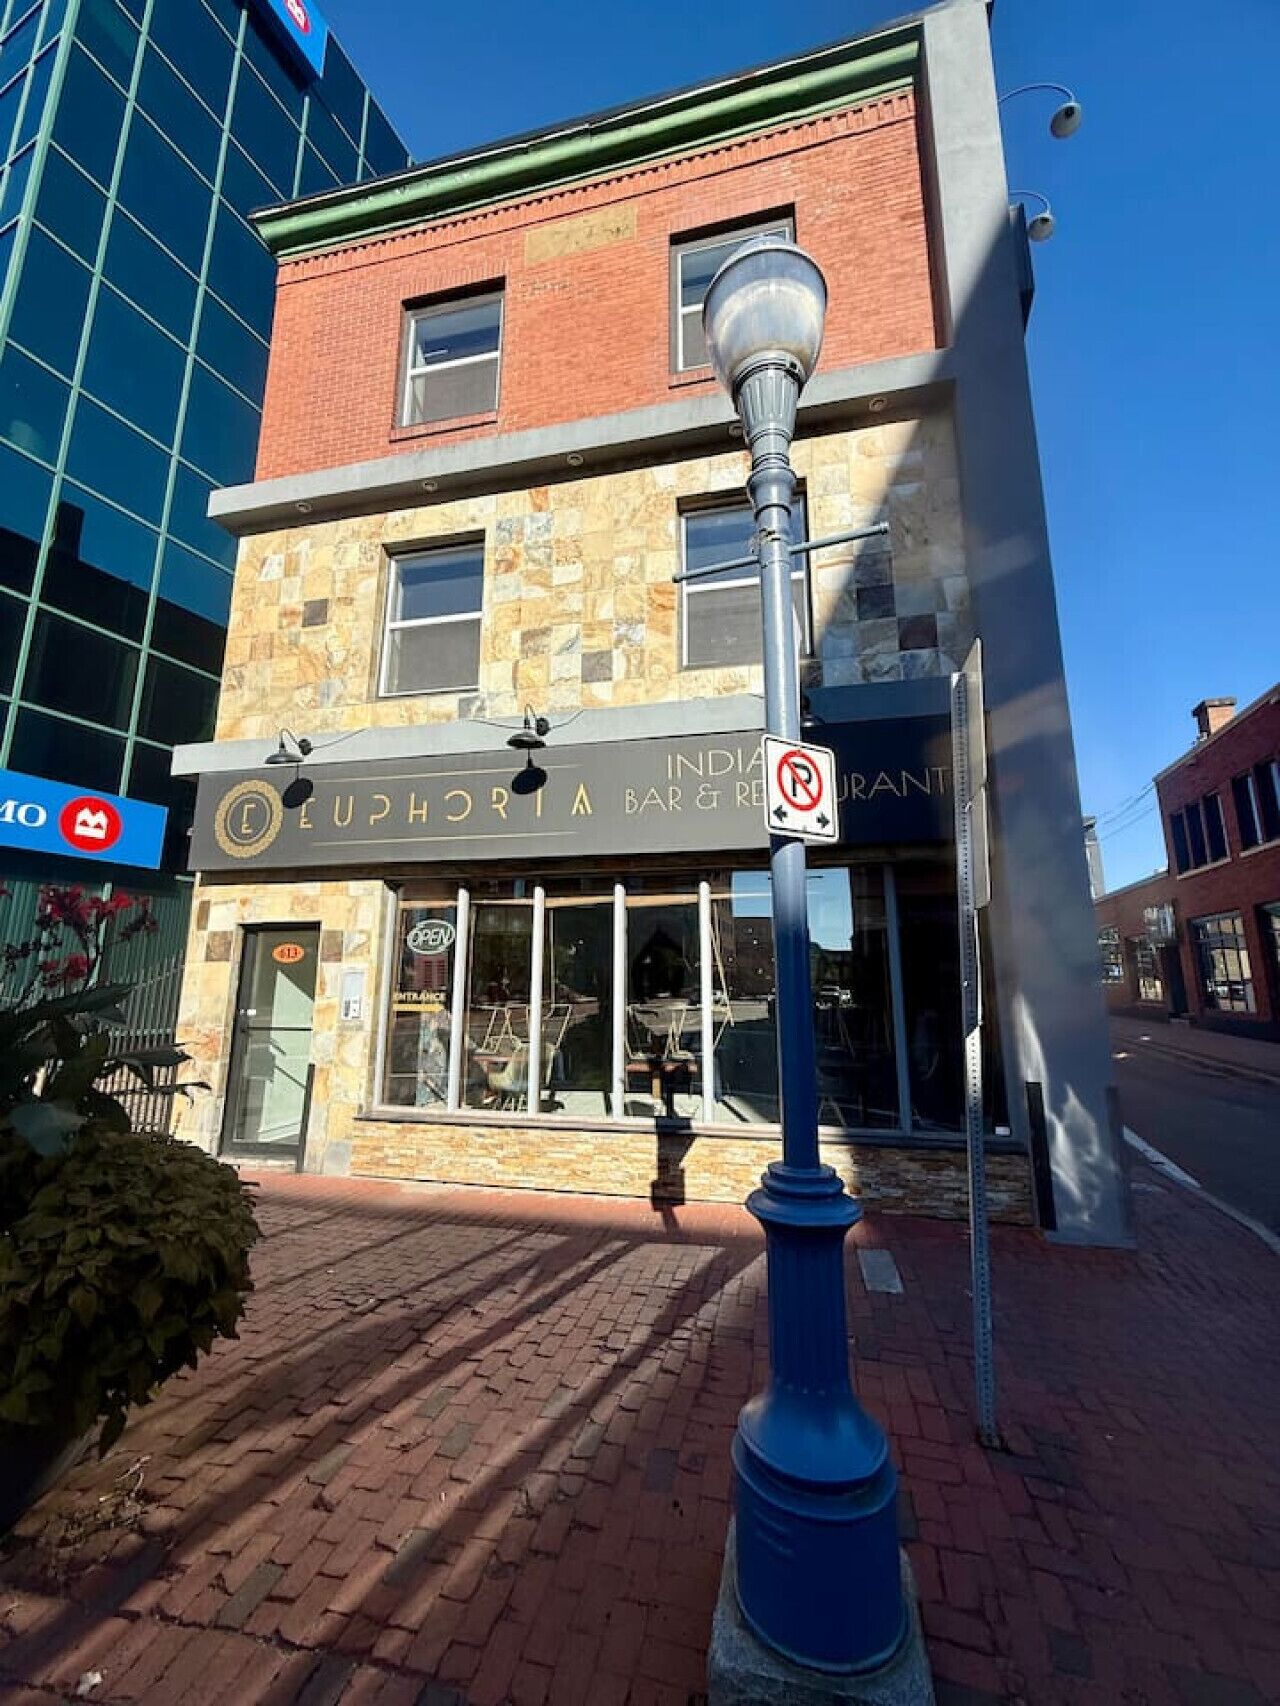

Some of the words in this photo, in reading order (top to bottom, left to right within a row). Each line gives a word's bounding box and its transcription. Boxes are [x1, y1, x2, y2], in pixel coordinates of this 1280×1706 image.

[625, 786, 682, 815] BAR
[696, 783, 722, 810] &
[410, 928, 454, 947] OPEN
